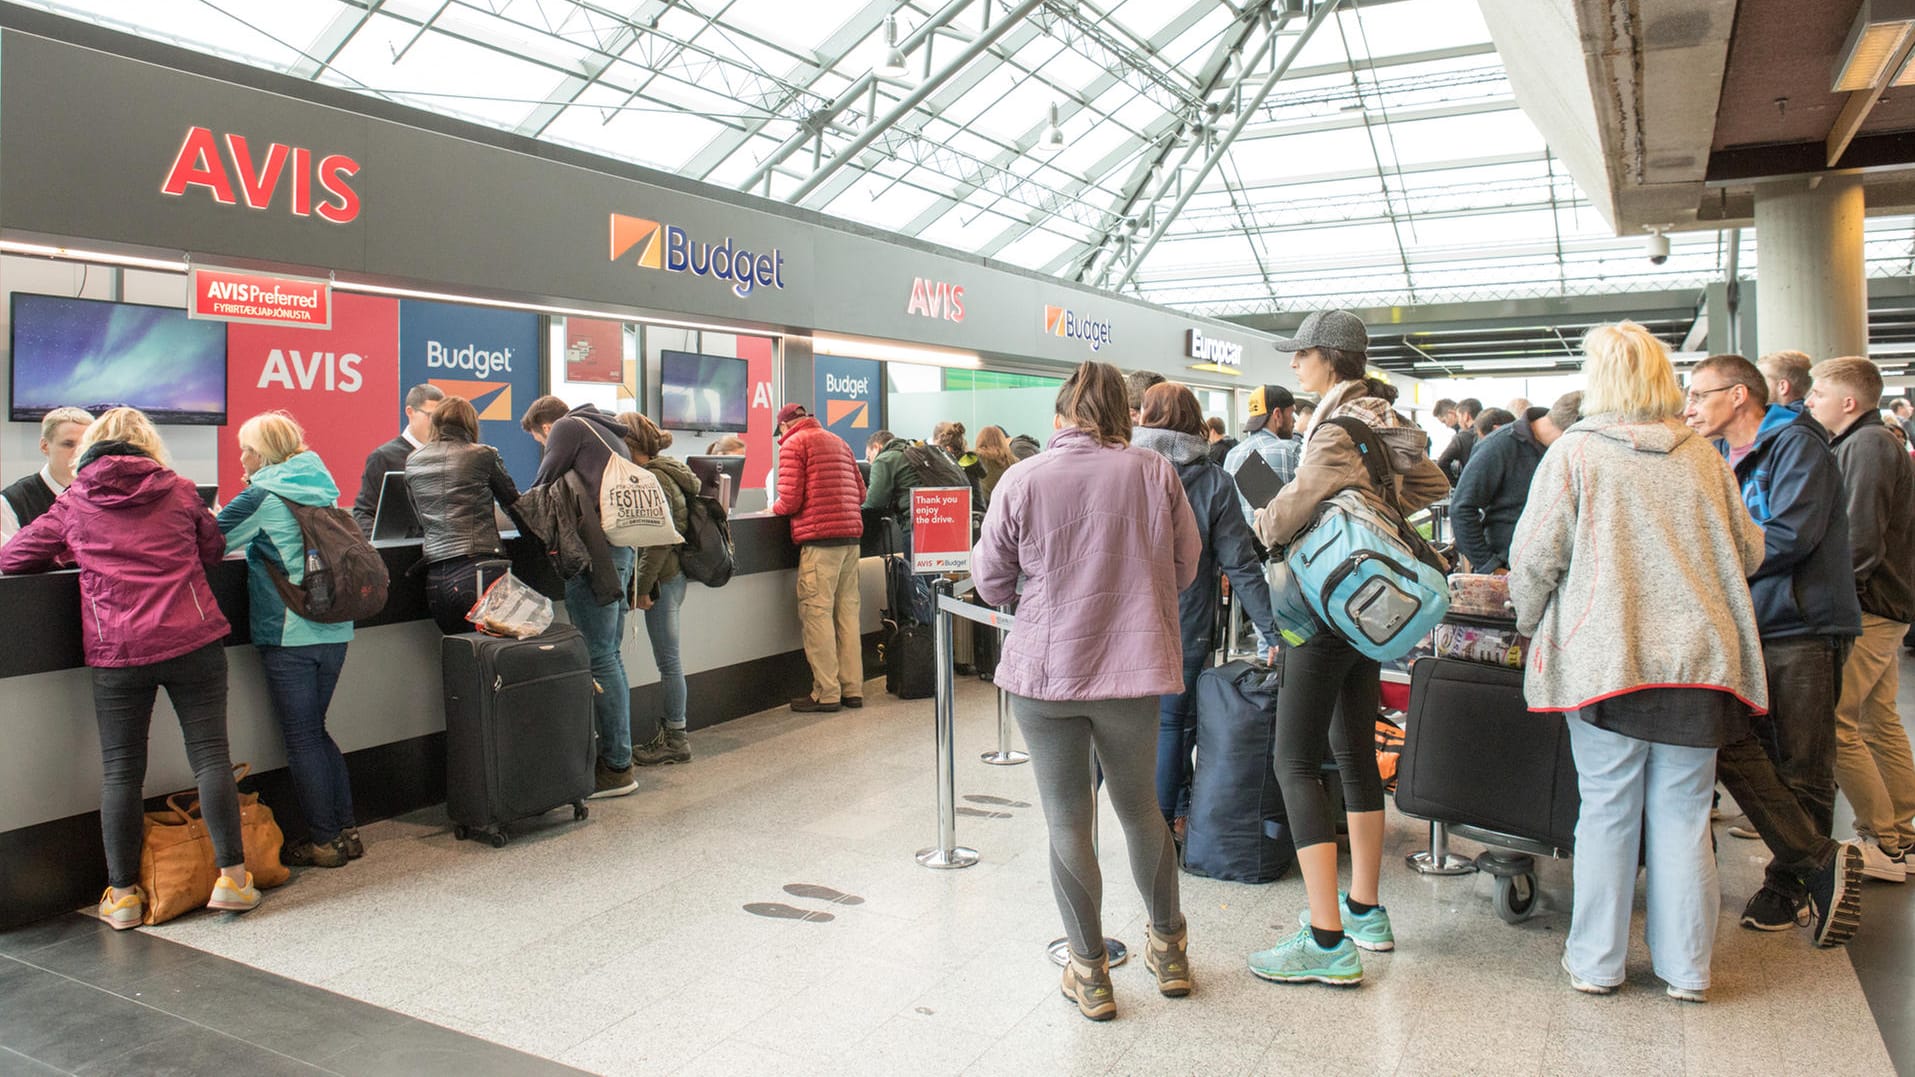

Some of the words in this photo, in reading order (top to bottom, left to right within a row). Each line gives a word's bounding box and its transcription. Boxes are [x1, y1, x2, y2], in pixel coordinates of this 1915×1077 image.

[161, 126, 361, 224] AVIS
[665, 224, 784, 298] Budget
[207, 280, 248, 301] AVIS
[250, 284, 317, 308] Preferred
[907, 276, 965, 323] AVIS
[1065, 310, 1112, 352] Budget
[1191, 328, 1243, 372] Europcar
[256, 349, 363, 392] AVIS
[427, 340, 512, 378] Budget
[826, 373, 868, 399] Budget
[916, 496, 941, 504] Thank
[942, 496, 958, 506] you
[916, 506, 938, 515] enjoy
[916, 516, 929, 524] the
[931, 515, 954, 523] drive.
